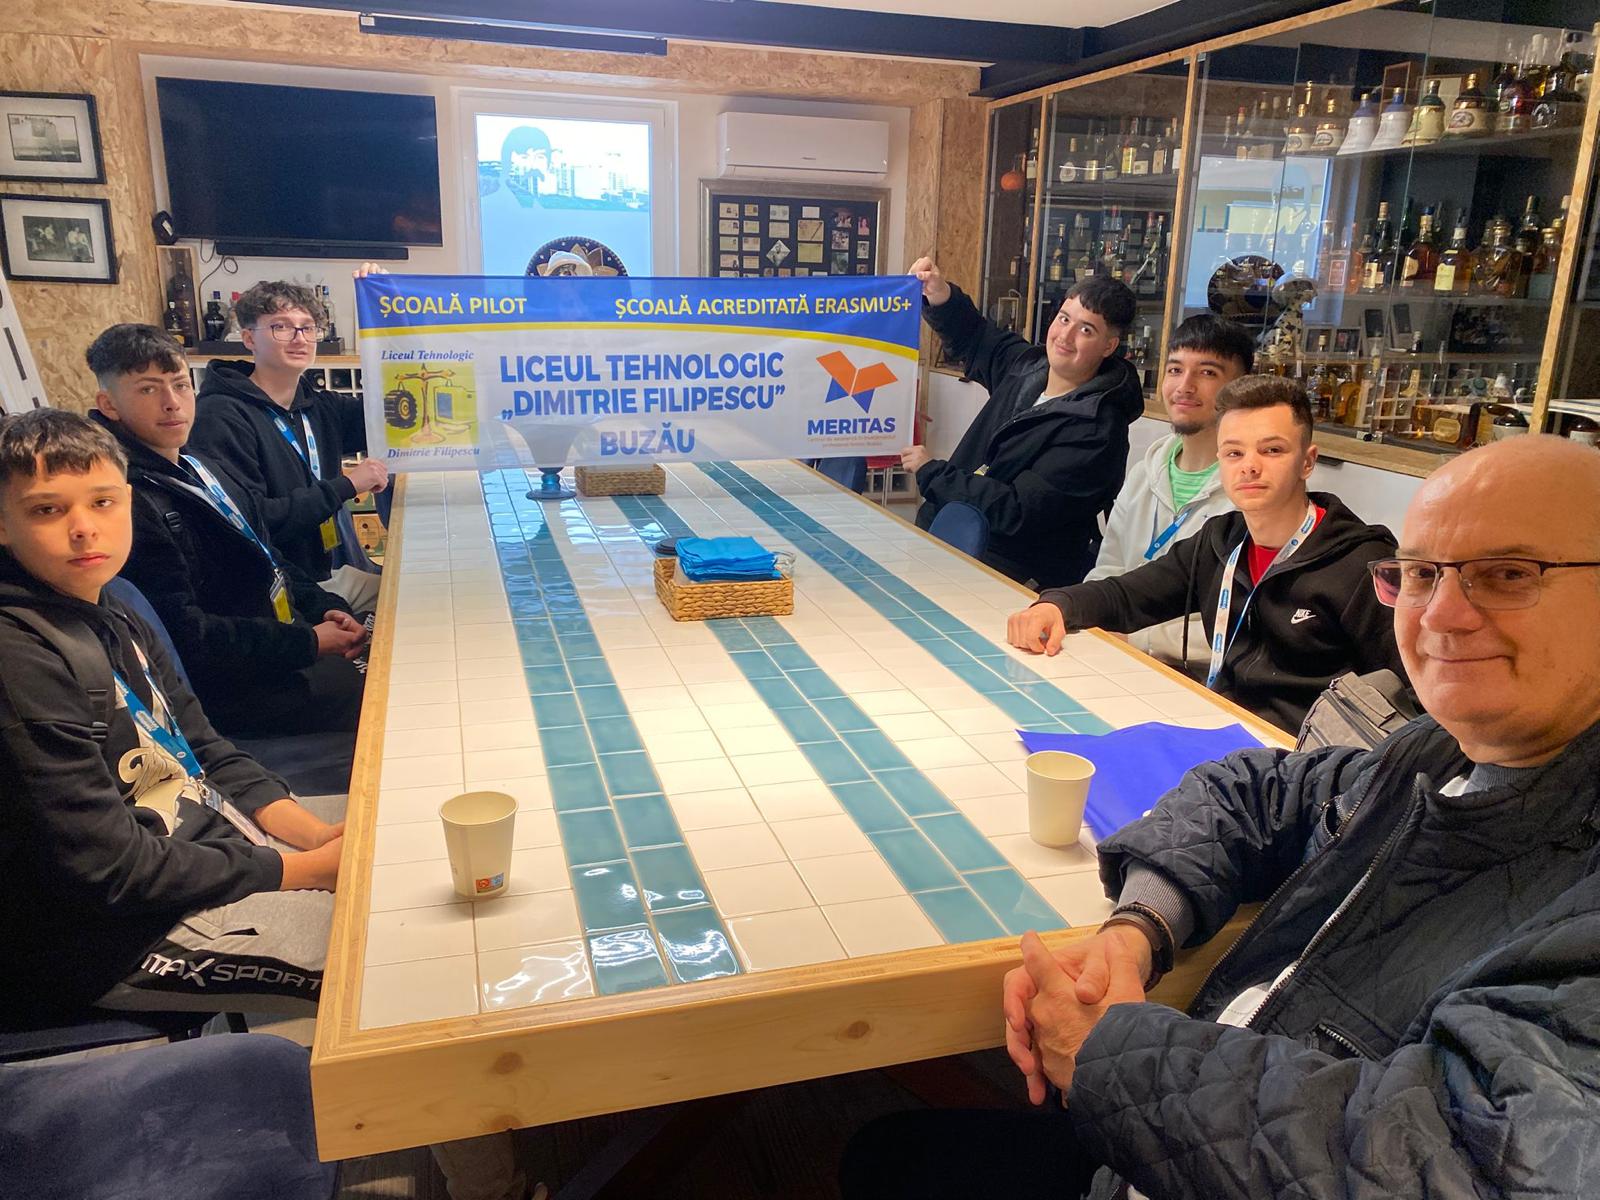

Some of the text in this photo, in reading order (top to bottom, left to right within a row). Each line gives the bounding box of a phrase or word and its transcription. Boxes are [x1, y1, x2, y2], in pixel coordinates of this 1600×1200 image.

[379, 293, 528, 318] ȘCOALĂ PILOT
[615, 293, 912, 319] ȘCOALĂ ACREDITATĂ ERASMUS+
[381, 349, 475, 362] Liceul Tehnologic
[499, 351, 785, 383] LICEUL TEHNOLOGIC
[807, 417, 896, 436] MERITAS
[600, 422, 695, 457] BUZĂU
[387, 445, 480, 460] Dimitrie Filipescu
